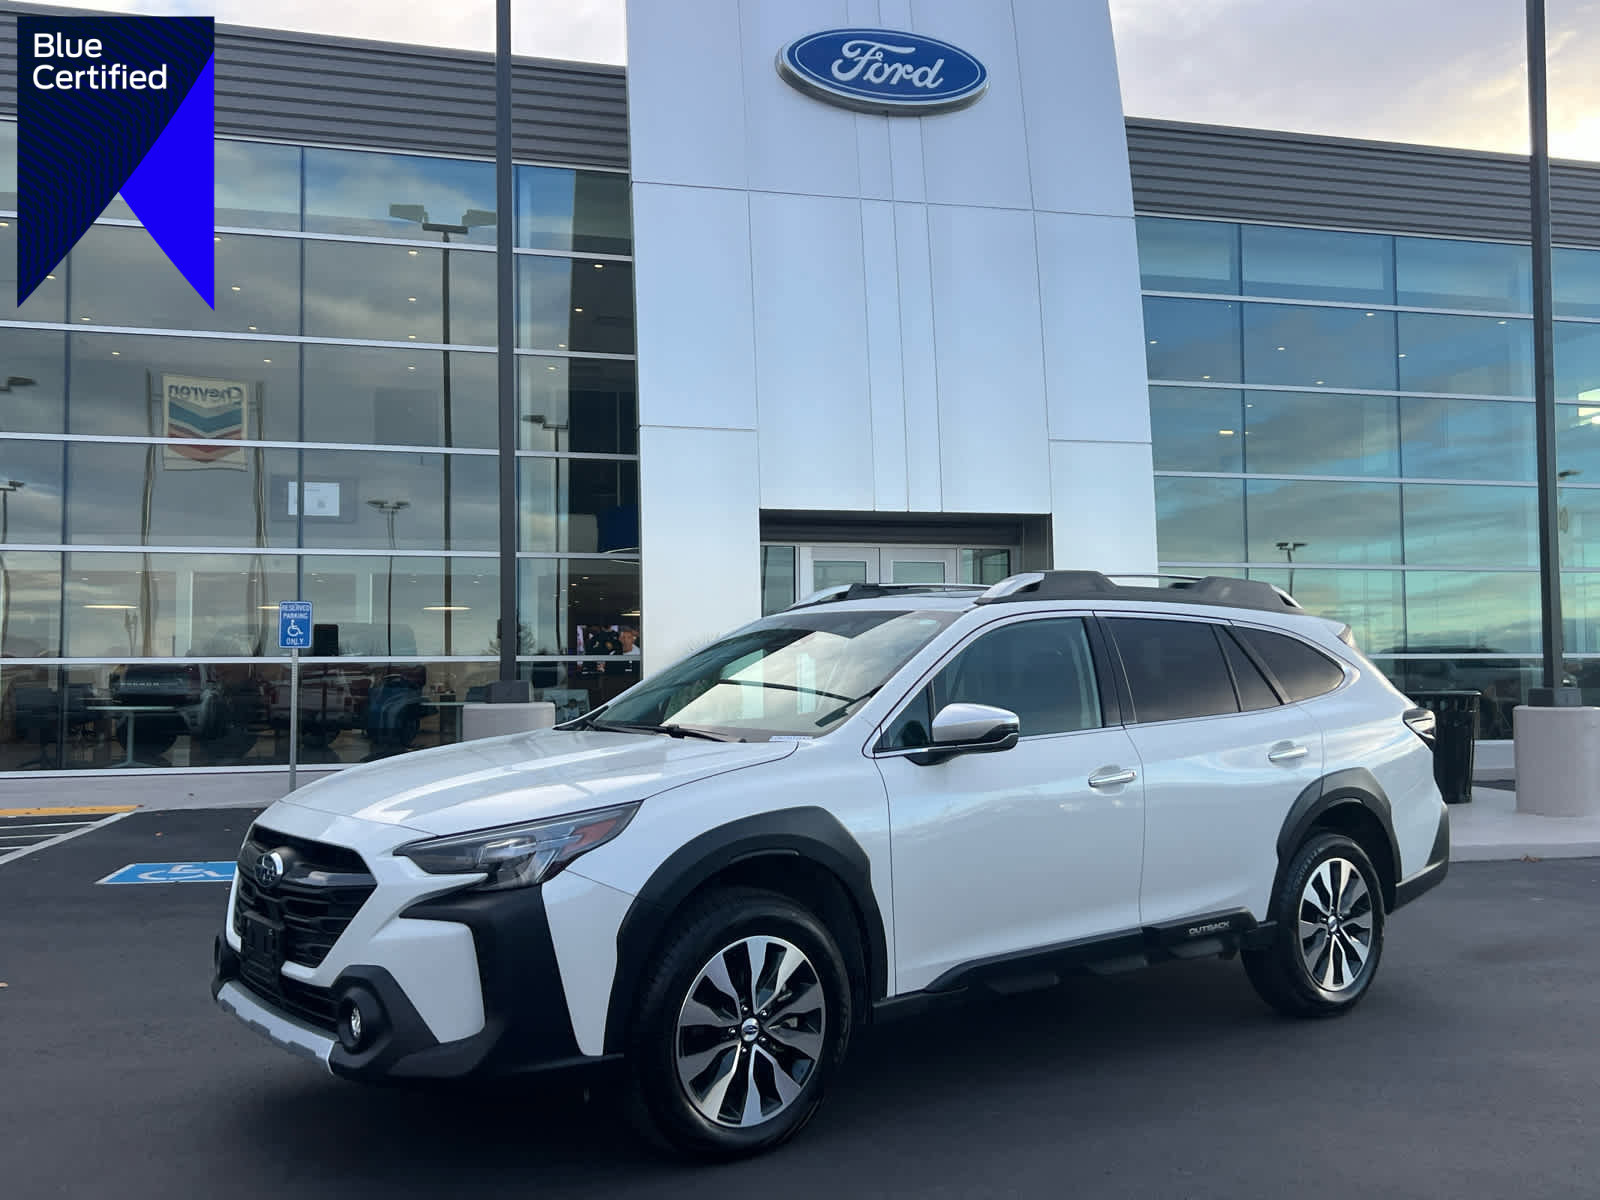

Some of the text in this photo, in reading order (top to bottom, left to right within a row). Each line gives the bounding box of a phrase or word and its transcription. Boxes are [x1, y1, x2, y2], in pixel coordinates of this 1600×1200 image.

[831, 39, 945, 89] Ford
[286, 637, 304, 646] ONLY
[1189, 921, 1230, 935] OUTBACK
